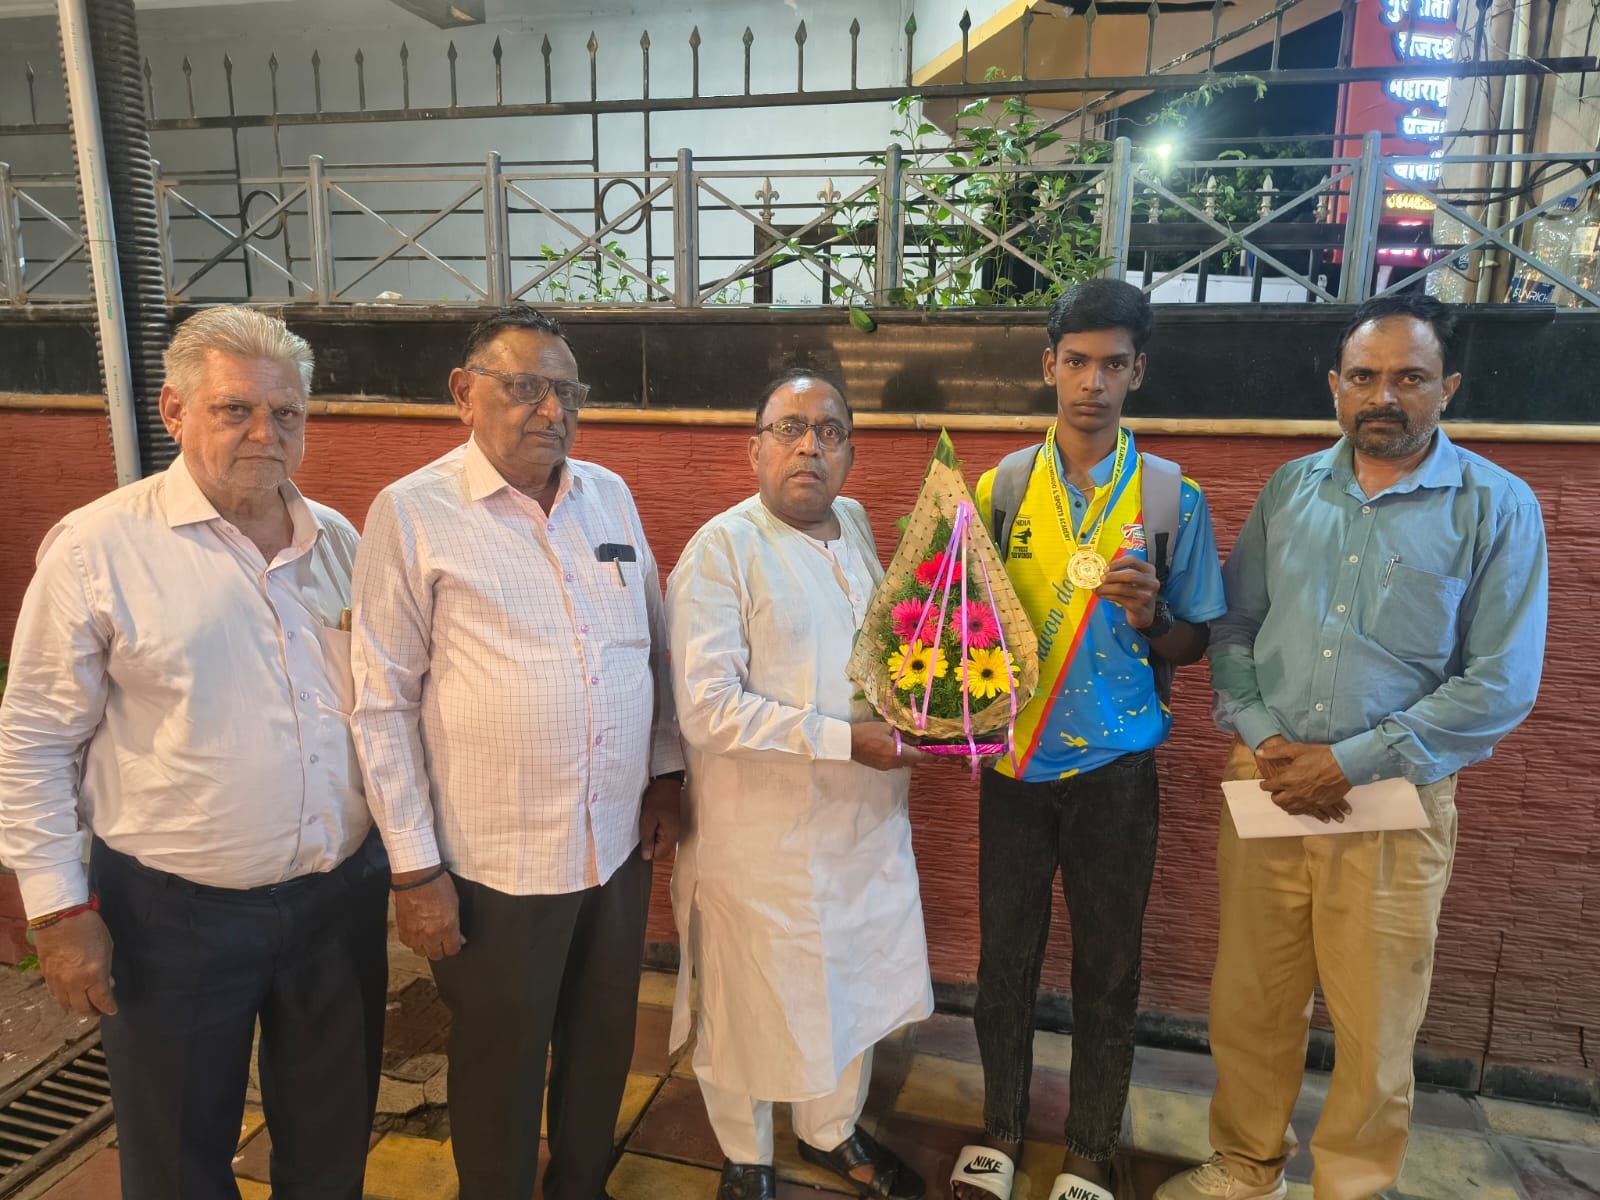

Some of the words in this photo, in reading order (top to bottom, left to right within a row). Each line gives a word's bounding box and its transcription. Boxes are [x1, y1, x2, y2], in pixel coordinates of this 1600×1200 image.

[1054, 494, 1064, 517] SPORTS
[1059, 517, 1071, 542] ACADEMY
[1052, 579, 1075, 605] do
[973, 1155, 1002, 1171] NIKE
[1068, 1185, 1100, 1200] NIKE
